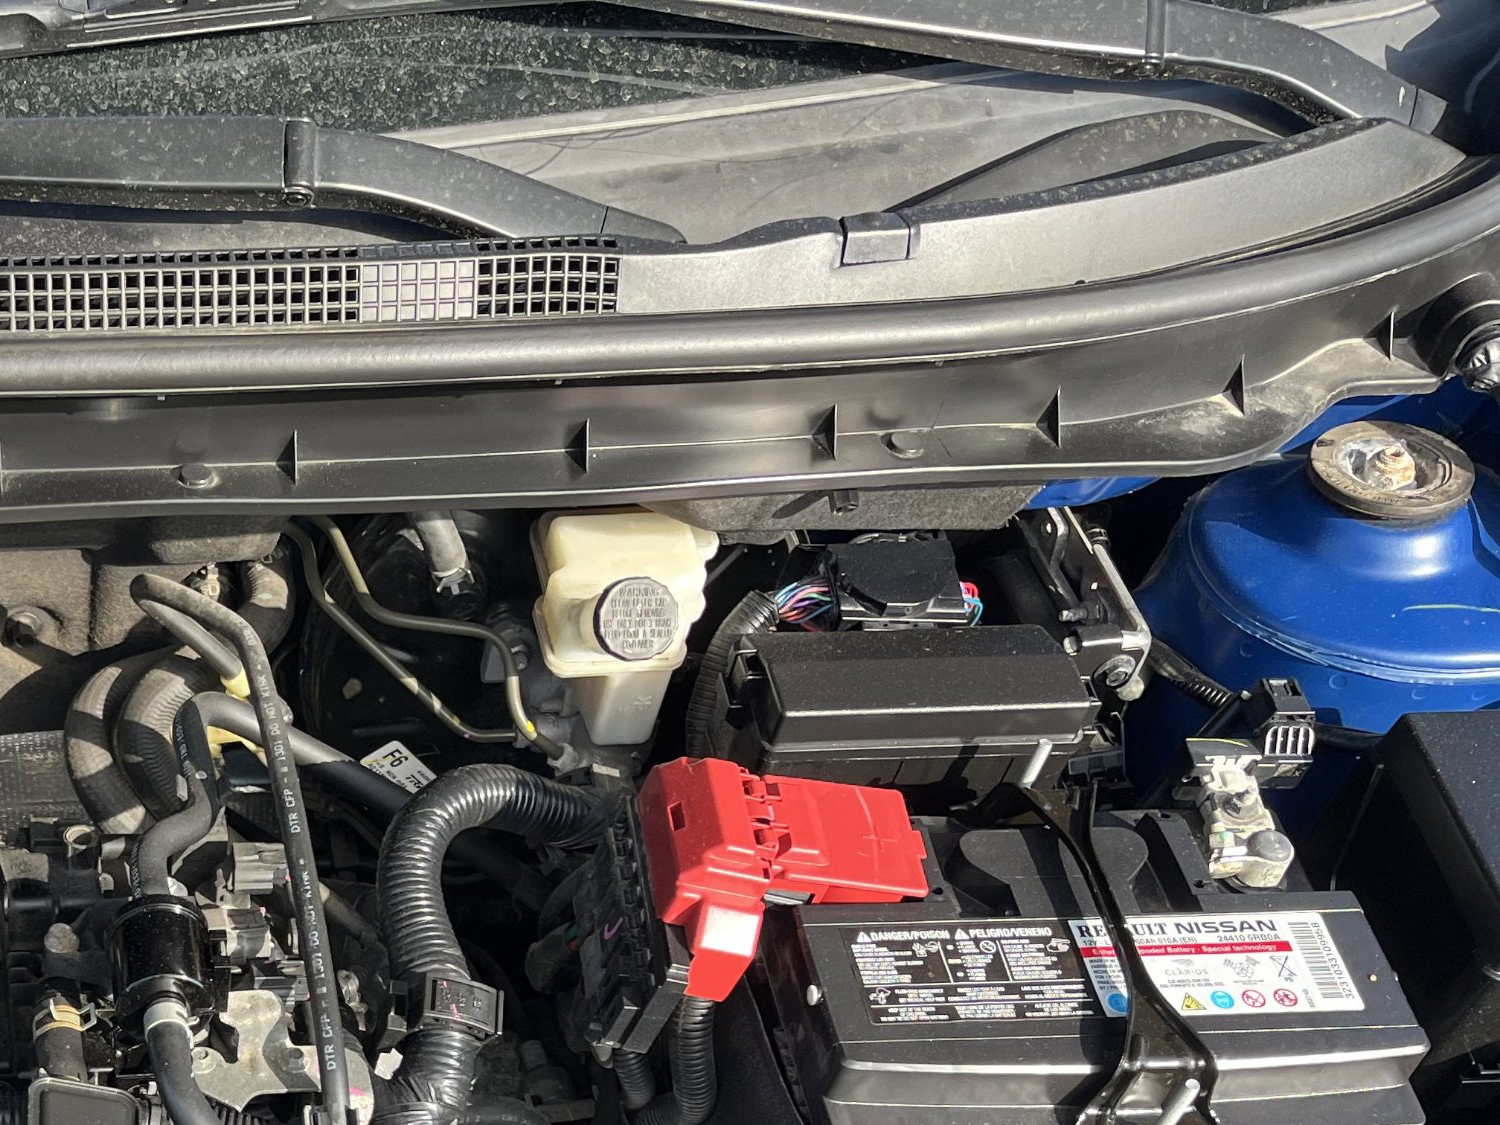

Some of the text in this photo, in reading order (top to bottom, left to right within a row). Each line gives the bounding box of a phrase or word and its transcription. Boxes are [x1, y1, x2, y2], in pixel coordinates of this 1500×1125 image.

[382, 748, 409, 767] F6
[870, 926, 1053, 941] DANGER/POISON PELIGRO/VENENO
[1076, 920, 1277, 938] REULT NISSAN
[1201, 944, 1231, 953] Special
[1232, 943, 1277, 952] technology
[324, 1044, 337, 1071] DTR
